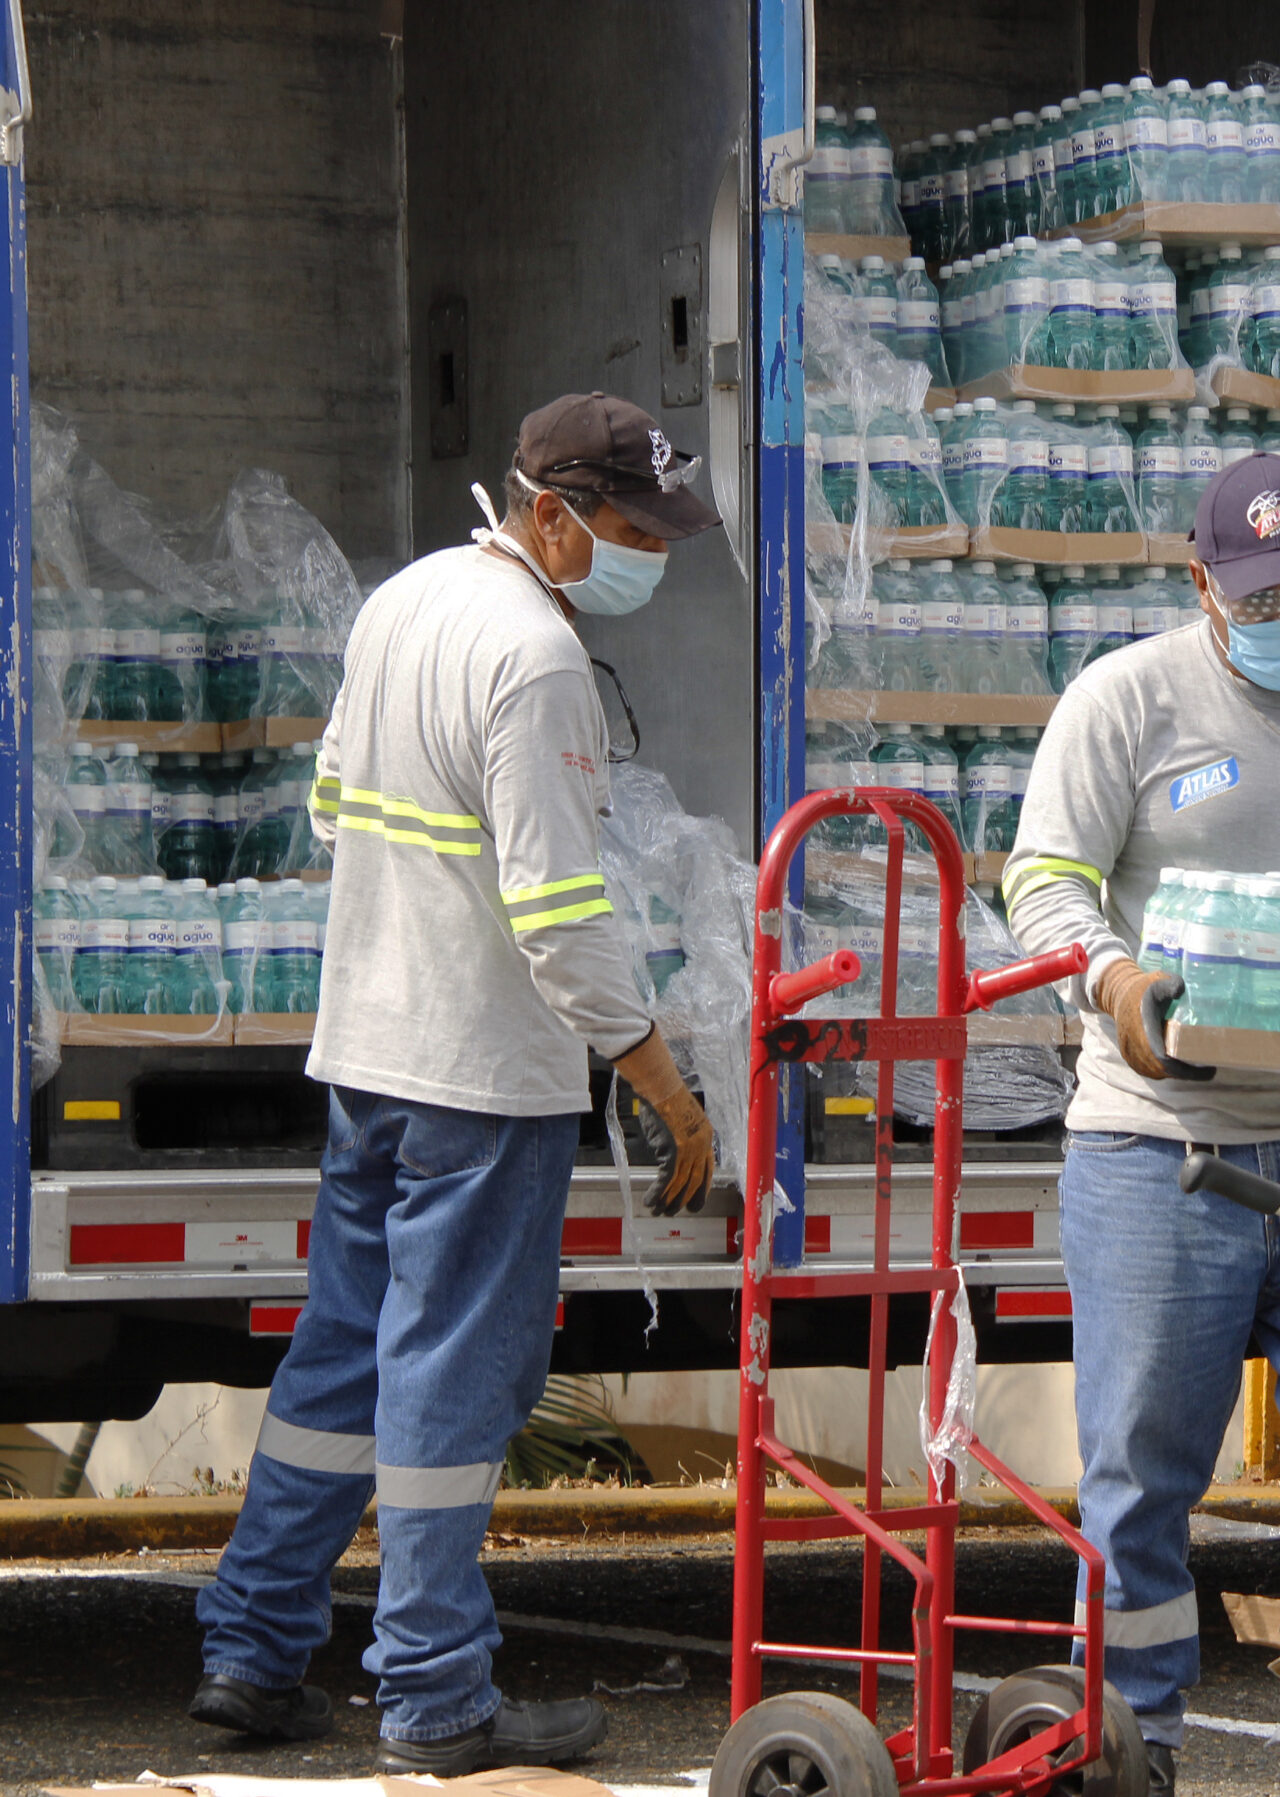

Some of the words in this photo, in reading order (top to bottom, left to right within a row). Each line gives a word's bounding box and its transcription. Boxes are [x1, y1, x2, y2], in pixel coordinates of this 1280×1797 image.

[1247, 136, 1274, 147] agua
[1190, 457, 1217, 468] agua
[1177, 763, 1232, 805] ATLAS
[184, 932, 213, 943] agua
